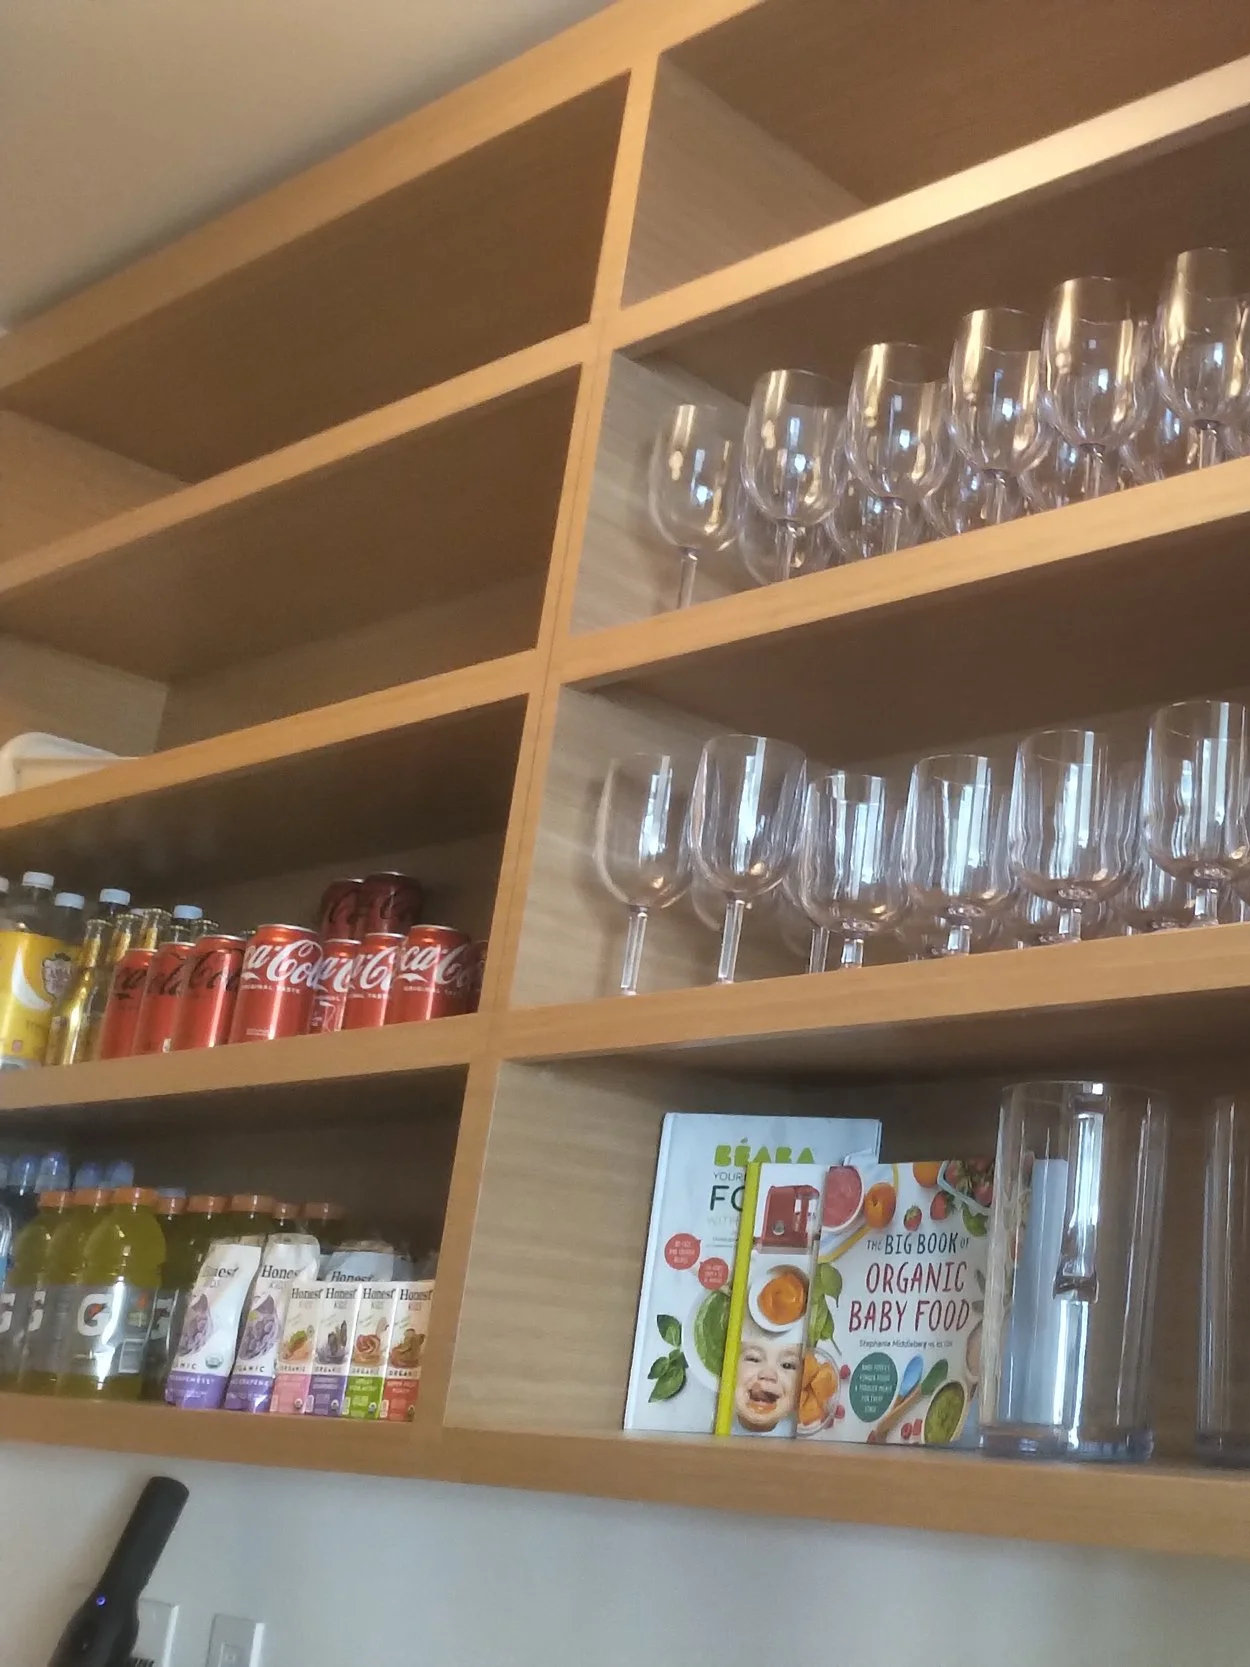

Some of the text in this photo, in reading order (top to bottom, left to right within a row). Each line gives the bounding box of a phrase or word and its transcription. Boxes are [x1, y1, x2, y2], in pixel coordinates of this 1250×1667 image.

[867, 1232, 969, 1254] THE BIG BOOK OF
[261, 1264, 302, 1280] Hones
[866, 1261, 967, 1294] ORGANIC
[291, 1287, 324, 1300] Honest
[326, 1287, 357, 1300] Honest
[363, 1287, 395, 1300] Honest
[400, 1288, 432, 1301] Honest
[848, 1298, 970, 1333] BABY FOOD
